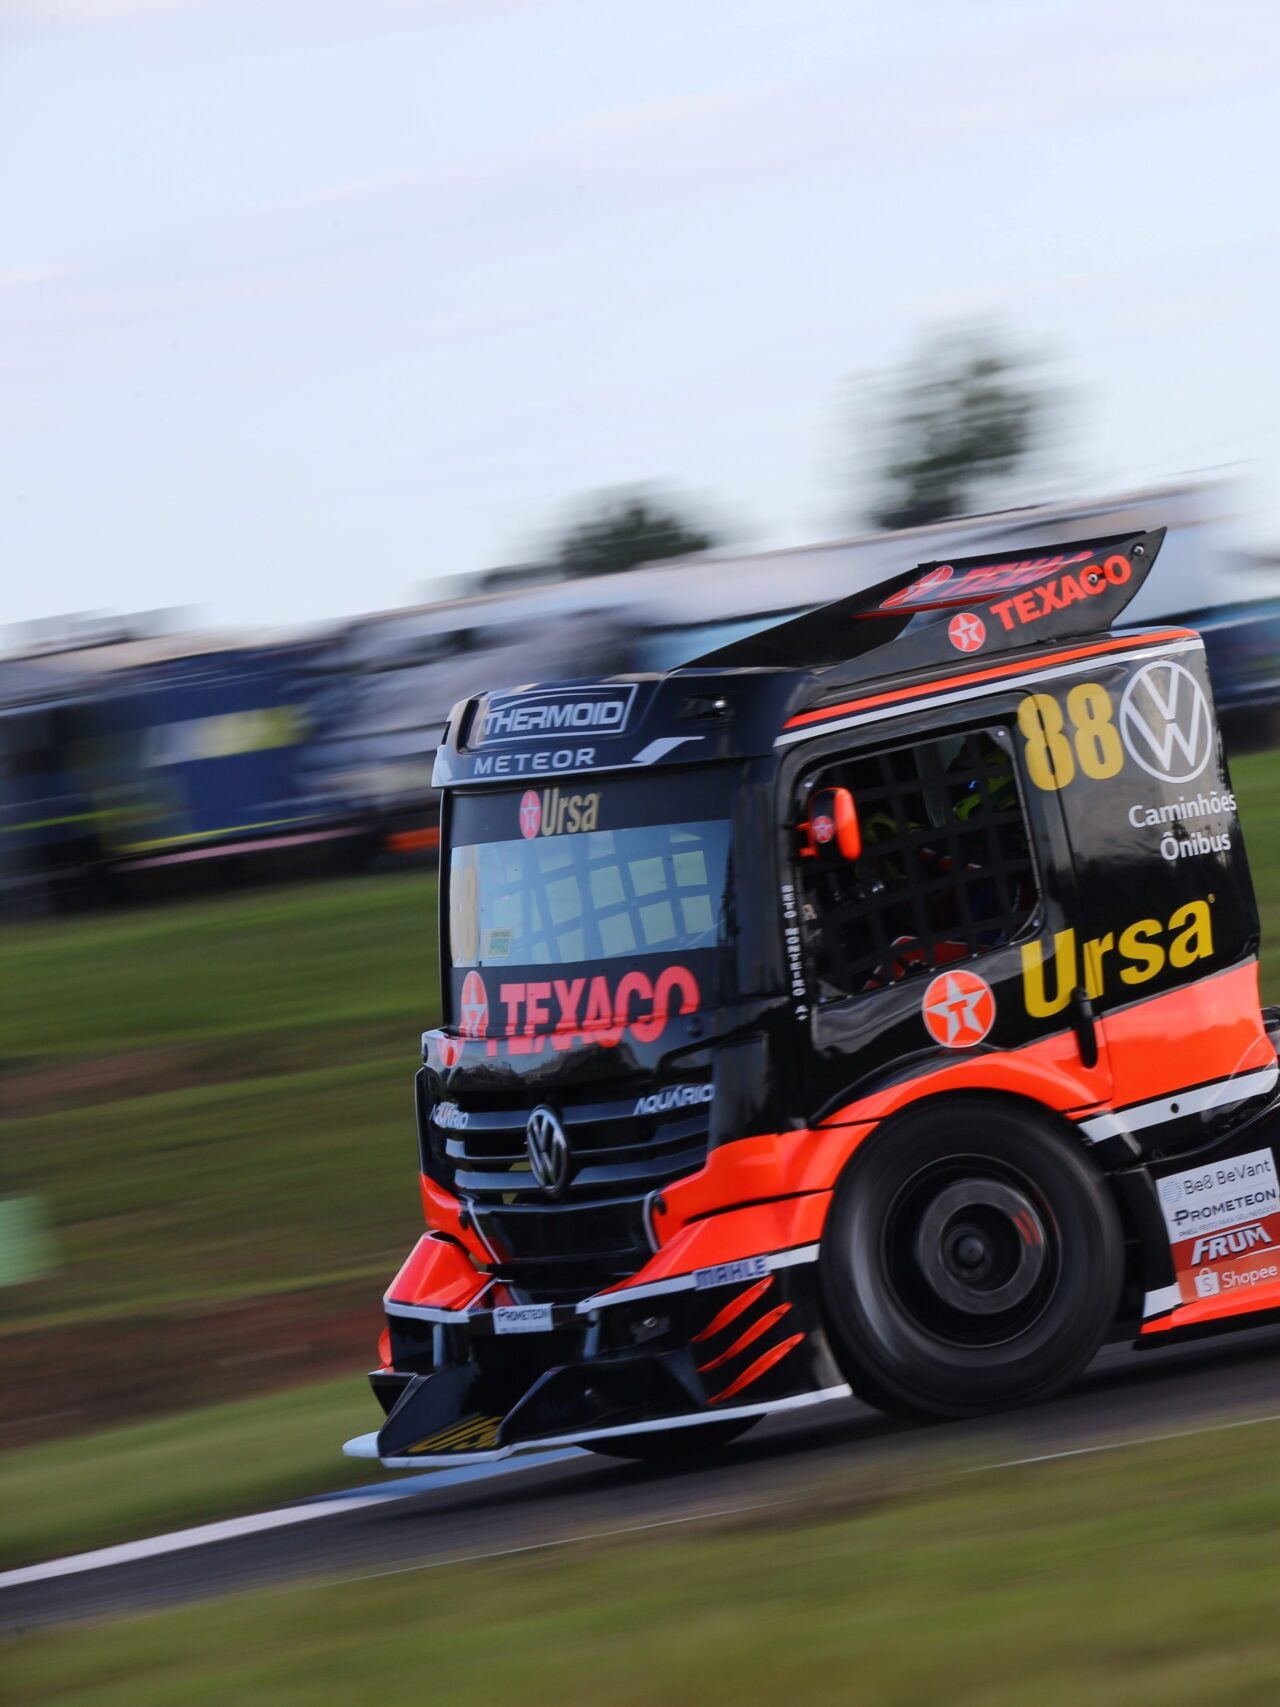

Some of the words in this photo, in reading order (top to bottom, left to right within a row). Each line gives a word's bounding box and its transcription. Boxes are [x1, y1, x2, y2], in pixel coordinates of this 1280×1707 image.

[990, 555, 1131, 631] TEXACO
[484, 702, 624, 734] THERMOID
[1017, 683, 1124, 791] 88
[473, 748, 596, 775] METEOR
[541, 788, 599, 836] Ursa
[1128, 790, 1237, 828] Caminhões
[1160, 832, 1231, 861] Ônibus
[781, 884, 798, 919] BETO
[784, 928, 806, 996] MONTEIRO
[1021, 900, 1214, 1018] Ursa
[486, 966, 700, 1057] TEXACO
[1183, 1174, 1213, 1196] Be8
[1216, 1160, 1271, 1186] BeVant
[1171, 1188, 1276, 1226] PROMETEON
[1191, 1223, 1272, 1266] FRUM
[696, 1259, 765, 1288] MAHLE
[1221, 1265, 1278, 1289] Shopee
